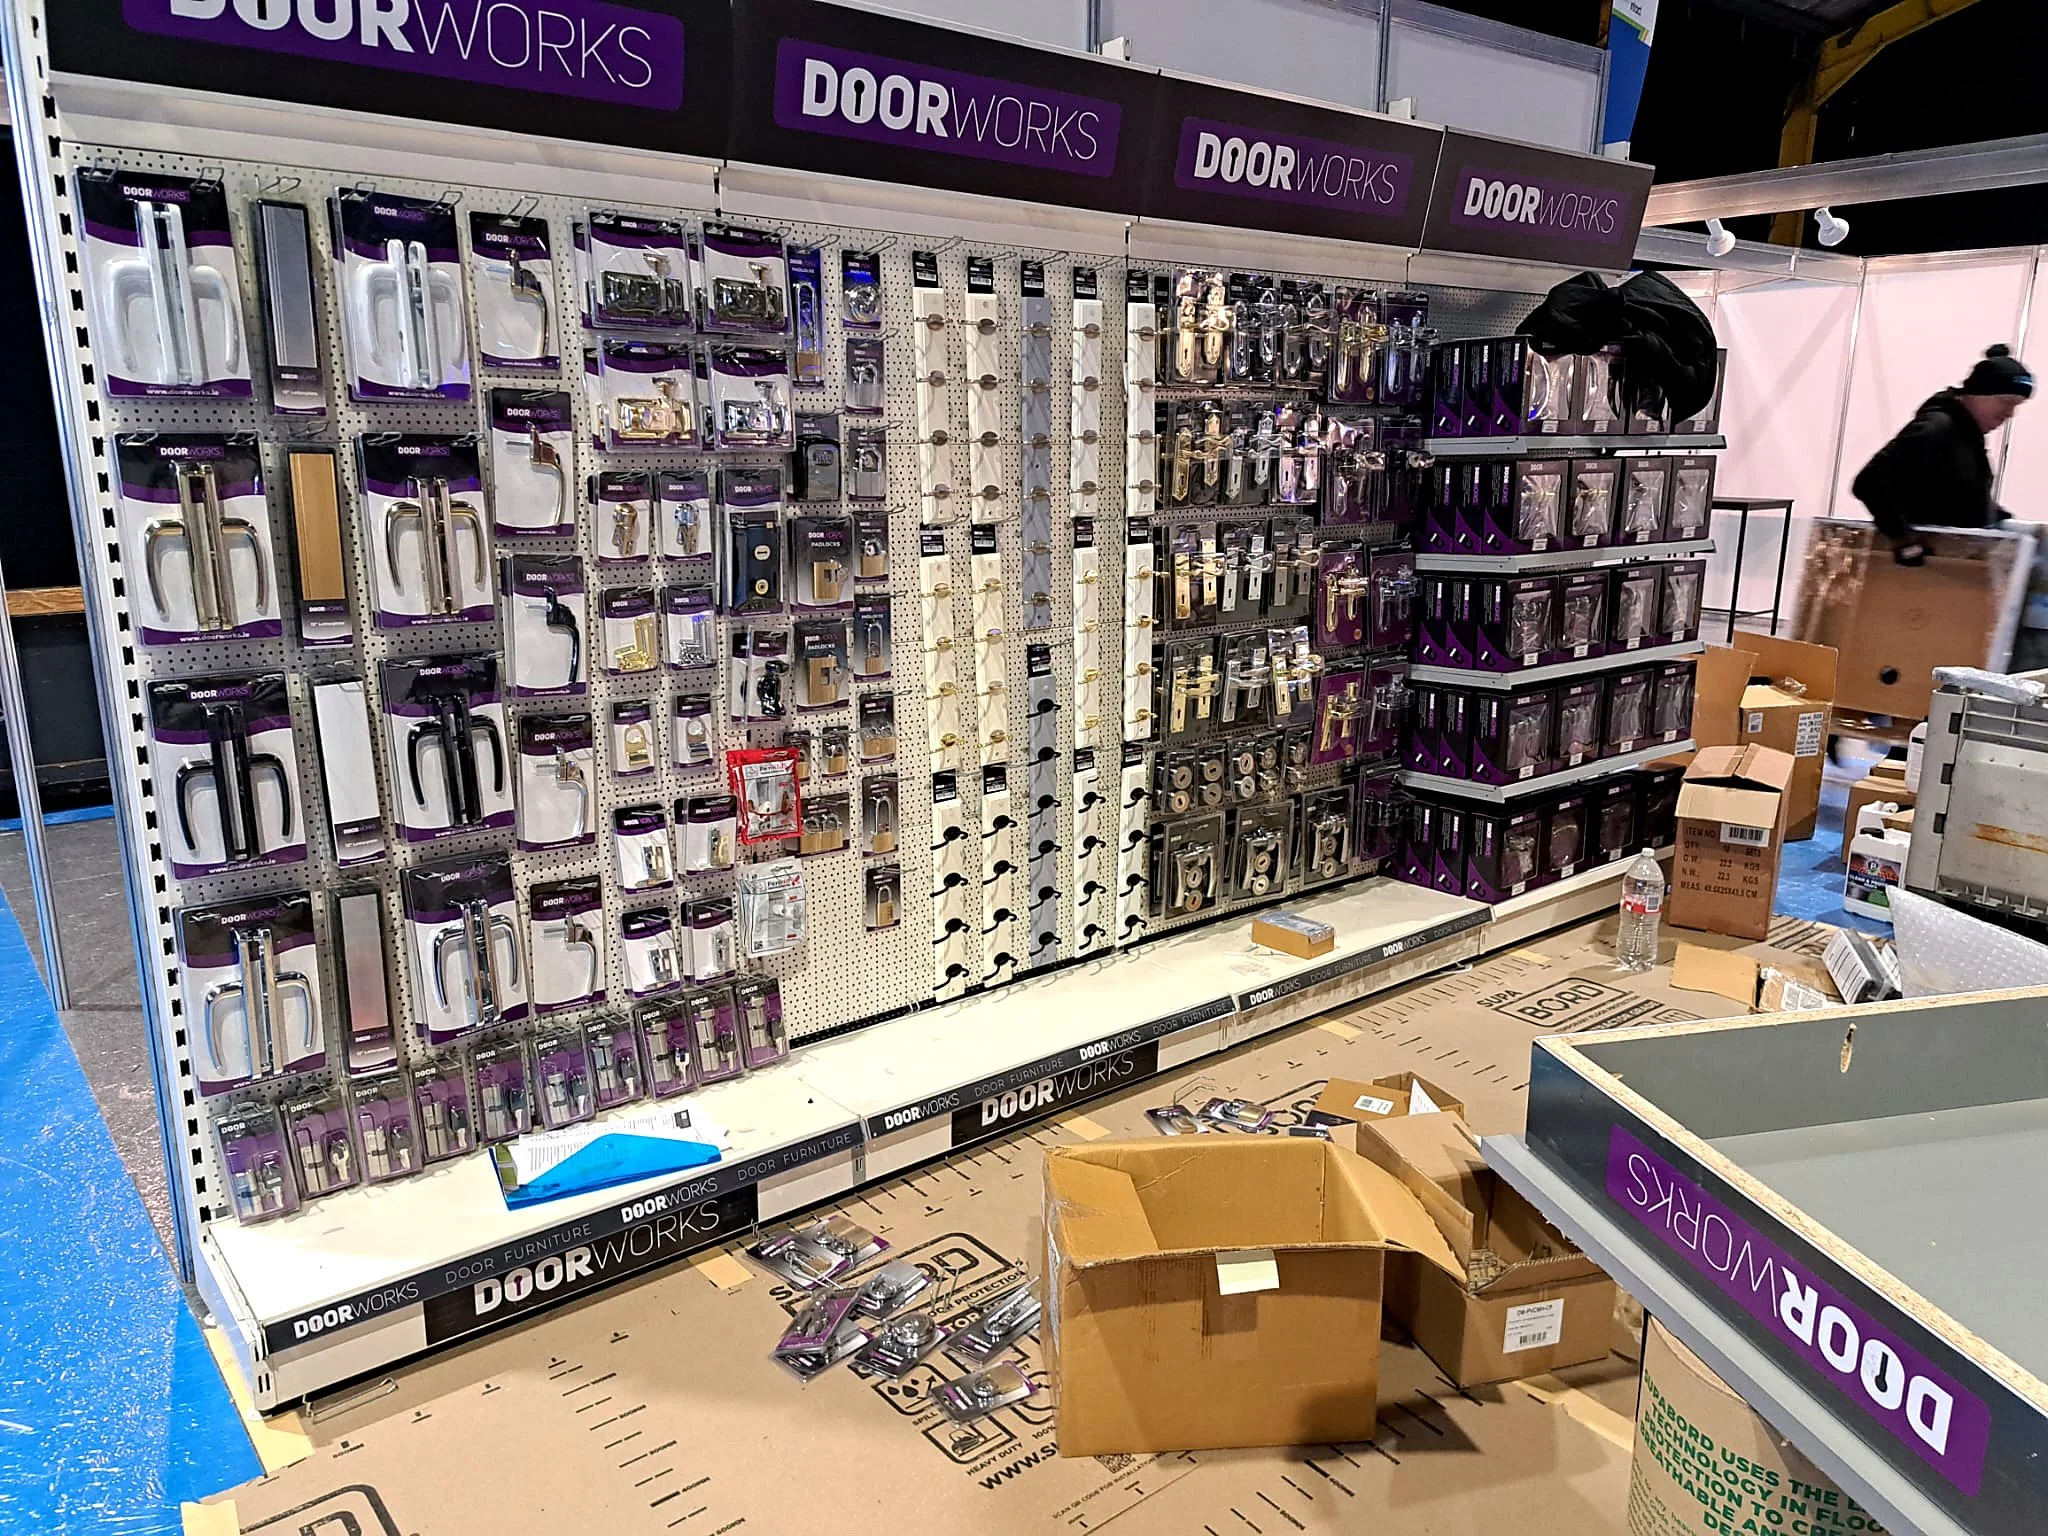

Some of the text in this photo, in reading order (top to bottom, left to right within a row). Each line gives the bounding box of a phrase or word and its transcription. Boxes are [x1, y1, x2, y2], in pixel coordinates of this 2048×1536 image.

[171, 0, 652, 88] ORWORKS
[802, 58, 1099, 160] DOORWORKS
[1194, 131, 1399, 205] DOORWORKS
[1464, 177, 1618, 234] DOORWORKS
[160, 446, 223, 457] DOORWORKS
[191, 687, 249, 700] DOORWORKS
[1383, 934, 1427, 959] DOORWORKS
[1250, 978, 1300, 1006] DOORWORKS
[1477, 989, 1523, 1009] SUPA
[1518, 984, 1605, 1020] BORD
[884, 1003, 1229, 1131] DOORWORKS DOOR FURNITURE DOORWORKS DOOR FURNITURE
[981, 1051, 1136, 1128] DOORWORKS
[293, 1133, 851, 1339] DOORWORKS DOOR FURNITURE DOORWORKS DOOR FURNITURE
[473, 1200, 720, 1316] DOORWORKS
[1626, 1153, 1954, 1457] DOORWORKS
[912, 1411, 938, 1426] SPILL
[1032, 1426, 1056, 1440] 100%
[1644, 1373, 1714, 1452] SUPABORD
[1720, 1447, 1780, 1487] USES
[1788, 1478, 1839, 1507] THE
[967, 1442, 1023, 1476] HEAVY DUTY
[1640, 1420, 1735, 1522] BREATHABLE
[1644, 1410, 1743, 1508] PROTECTION
[1750, 1501, 1784, 1525] TO
[1651, 1402, 1773, 1501] TECHNOLOGY
[1781, 1495, 1807, 1516] IN
[1052, 1507, 1071, 1519] SCAN
[1081, 1490, 1100, 1502] CODE
